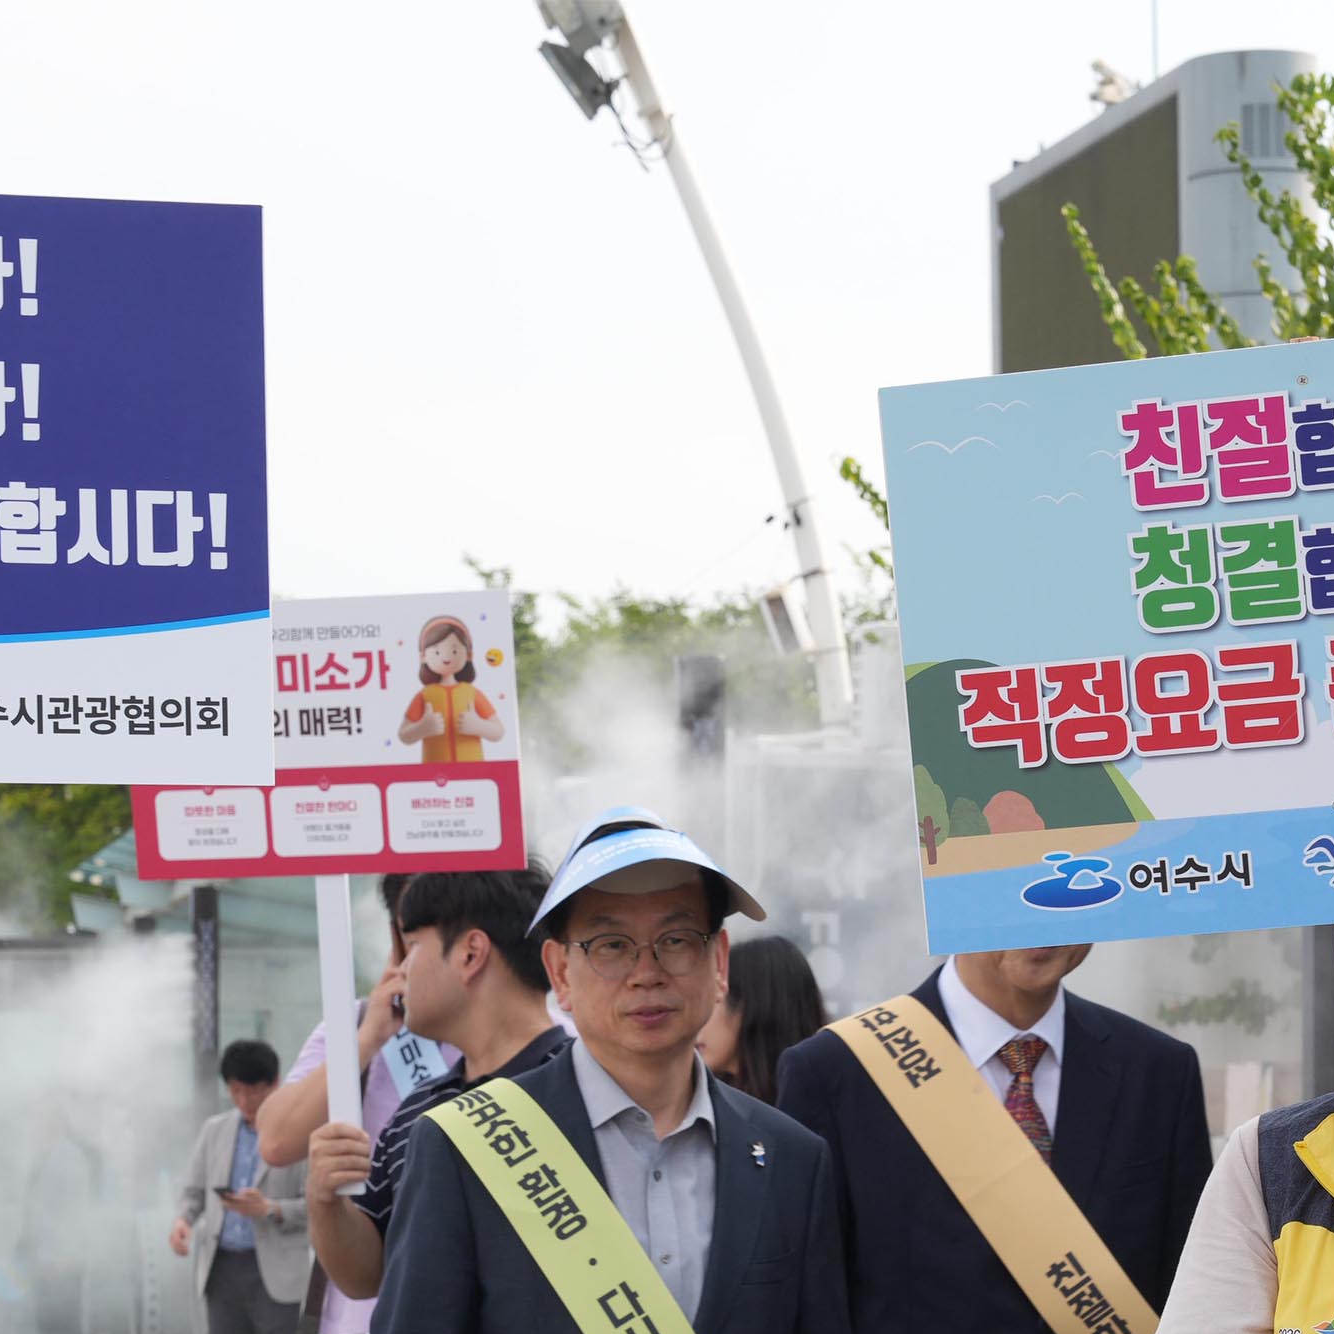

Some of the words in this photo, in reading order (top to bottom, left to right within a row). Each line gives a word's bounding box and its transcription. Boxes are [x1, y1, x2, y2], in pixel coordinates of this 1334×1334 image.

[276, 650, 390, 693] 미소가
[300, 707, 362, 736] 매력!
[957, 640, 1303, 767] 적정요금
[1129, 851, 1253, 894] 여수시
[452, 1090, 539, 1169] 깨끗한
[517, 1160, 589, 1243] 환경
